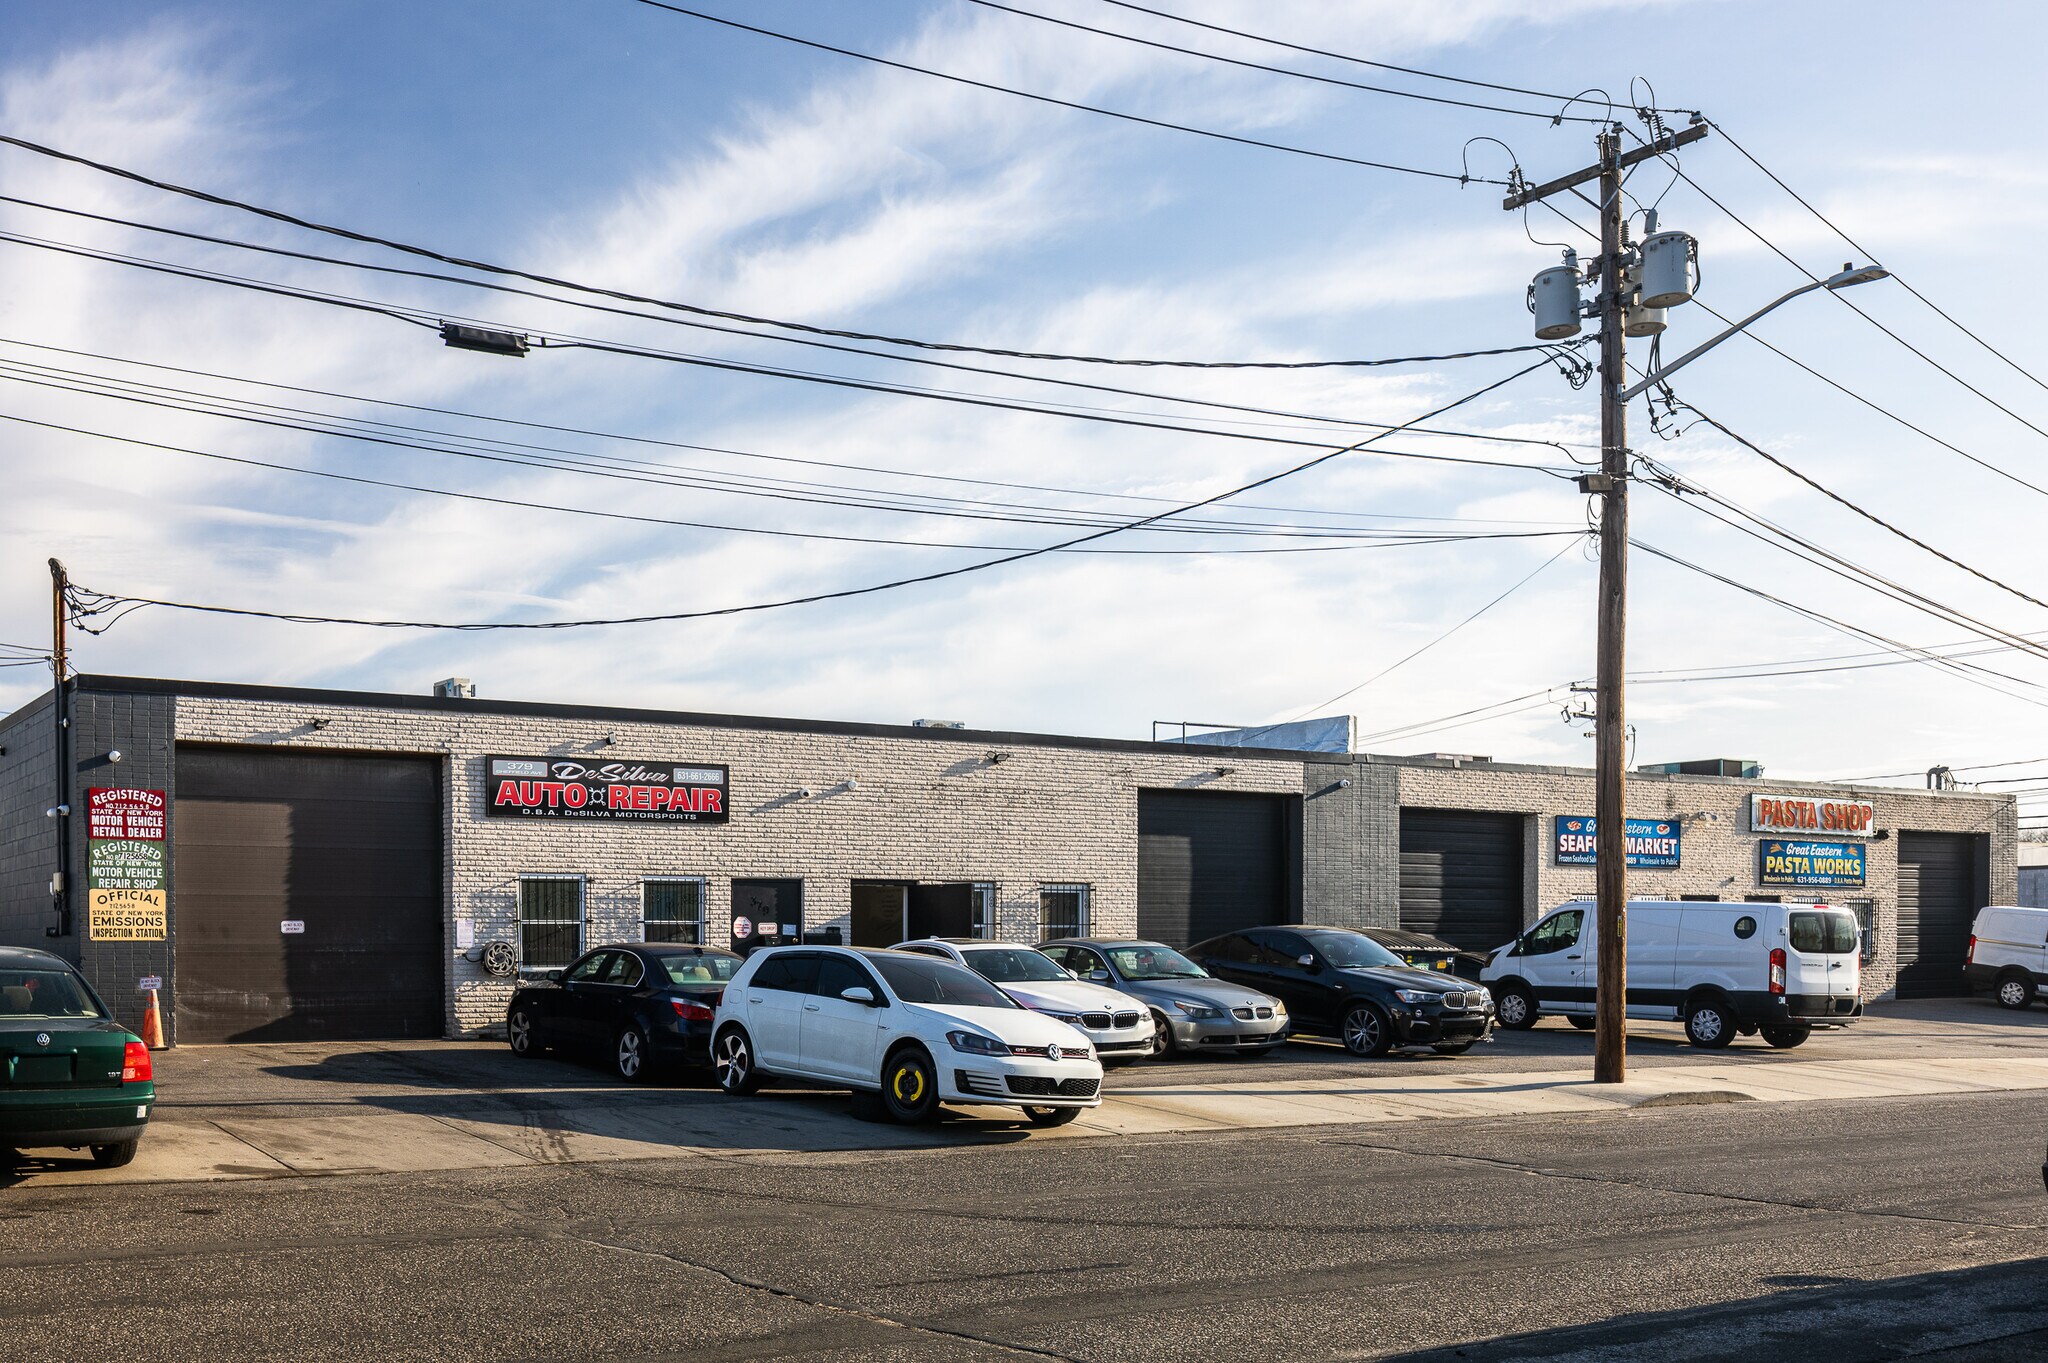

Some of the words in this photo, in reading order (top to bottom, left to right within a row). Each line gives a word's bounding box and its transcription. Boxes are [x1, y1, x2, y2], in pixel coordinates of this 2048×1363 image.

[507, 762, 533, 770] 379
[552, 762, 670, 782] DeSilva
[677, 771, 720, 781] 631-661-2666
[92, 790, 162, 807] REGISTERED
[495, 780, 588, 808] AUTO
[608, 784, 722, 813] REPAIR
[522, 808, 558, 816] D.B.A.
[615, 812, 697, 820] MOTORSPORTS
[1761, 799, 1818, 828] PASTA
[1823, 803, 1872, 831] SHOP
[92, 816, 123, 825] MOTOR
[127, 816, 163, 826] VEHICLE
[93, 826, 124, 836] RETAIL
[128, 828, 162, 838] DEALER
[1626, 824, 1652, 834] stern
[93, 841, 161, 860] REGISTERED
[1560, 834, 1596, 852] SEAF
[1626, 837, 1677, 855] MARKET
[1786, 843, 1809, 855] Great
[1810, 844, 1842, 856] Eastern
[1573, 855, 1589, 863] Seafood
[1640, 857, 1660, 865] Wholesale
[1766, 856, 1811, 874] PASTA
[1814, 858, 1860, 876] WORKS
[92, 867, 123, 877] MOTOR
[125, 868, 162, 878] VEHICLE
[99, 878, 130, 888] REPAIR
[134, 879, 158, 889] SHOP
[97, 891, 158, 906] OFFICIAL
[93, 917, 163, 926] EMISSIONS
[93, 928, 132, 937] INSPECTION
[136, 928, 163, 938] STATION
